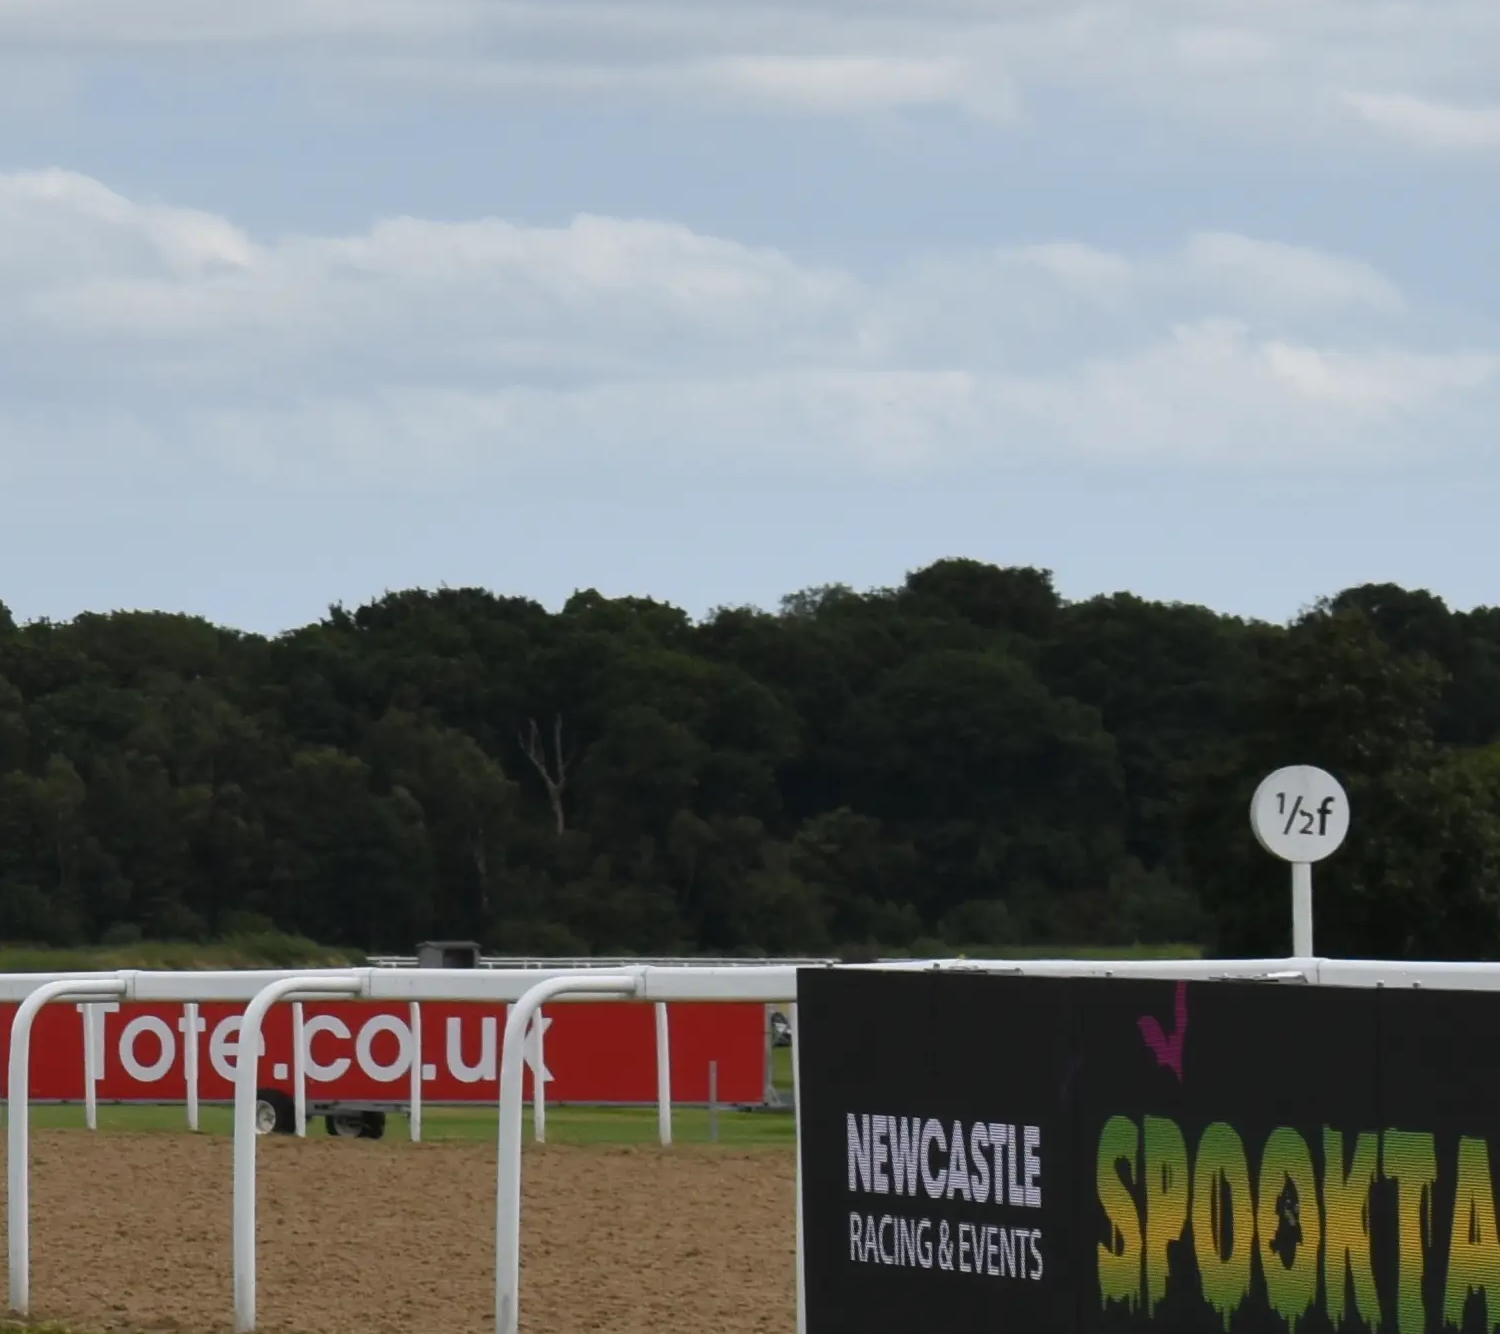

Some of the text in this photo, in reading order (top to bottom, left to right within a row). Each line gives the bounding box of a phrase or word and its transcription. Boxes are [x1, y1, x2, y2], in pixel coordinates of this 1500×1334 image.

[847, 1113, 1042, 1208] NEWCASTLE
[849, 1211, 1043, 1281] RACING & EVENTS
